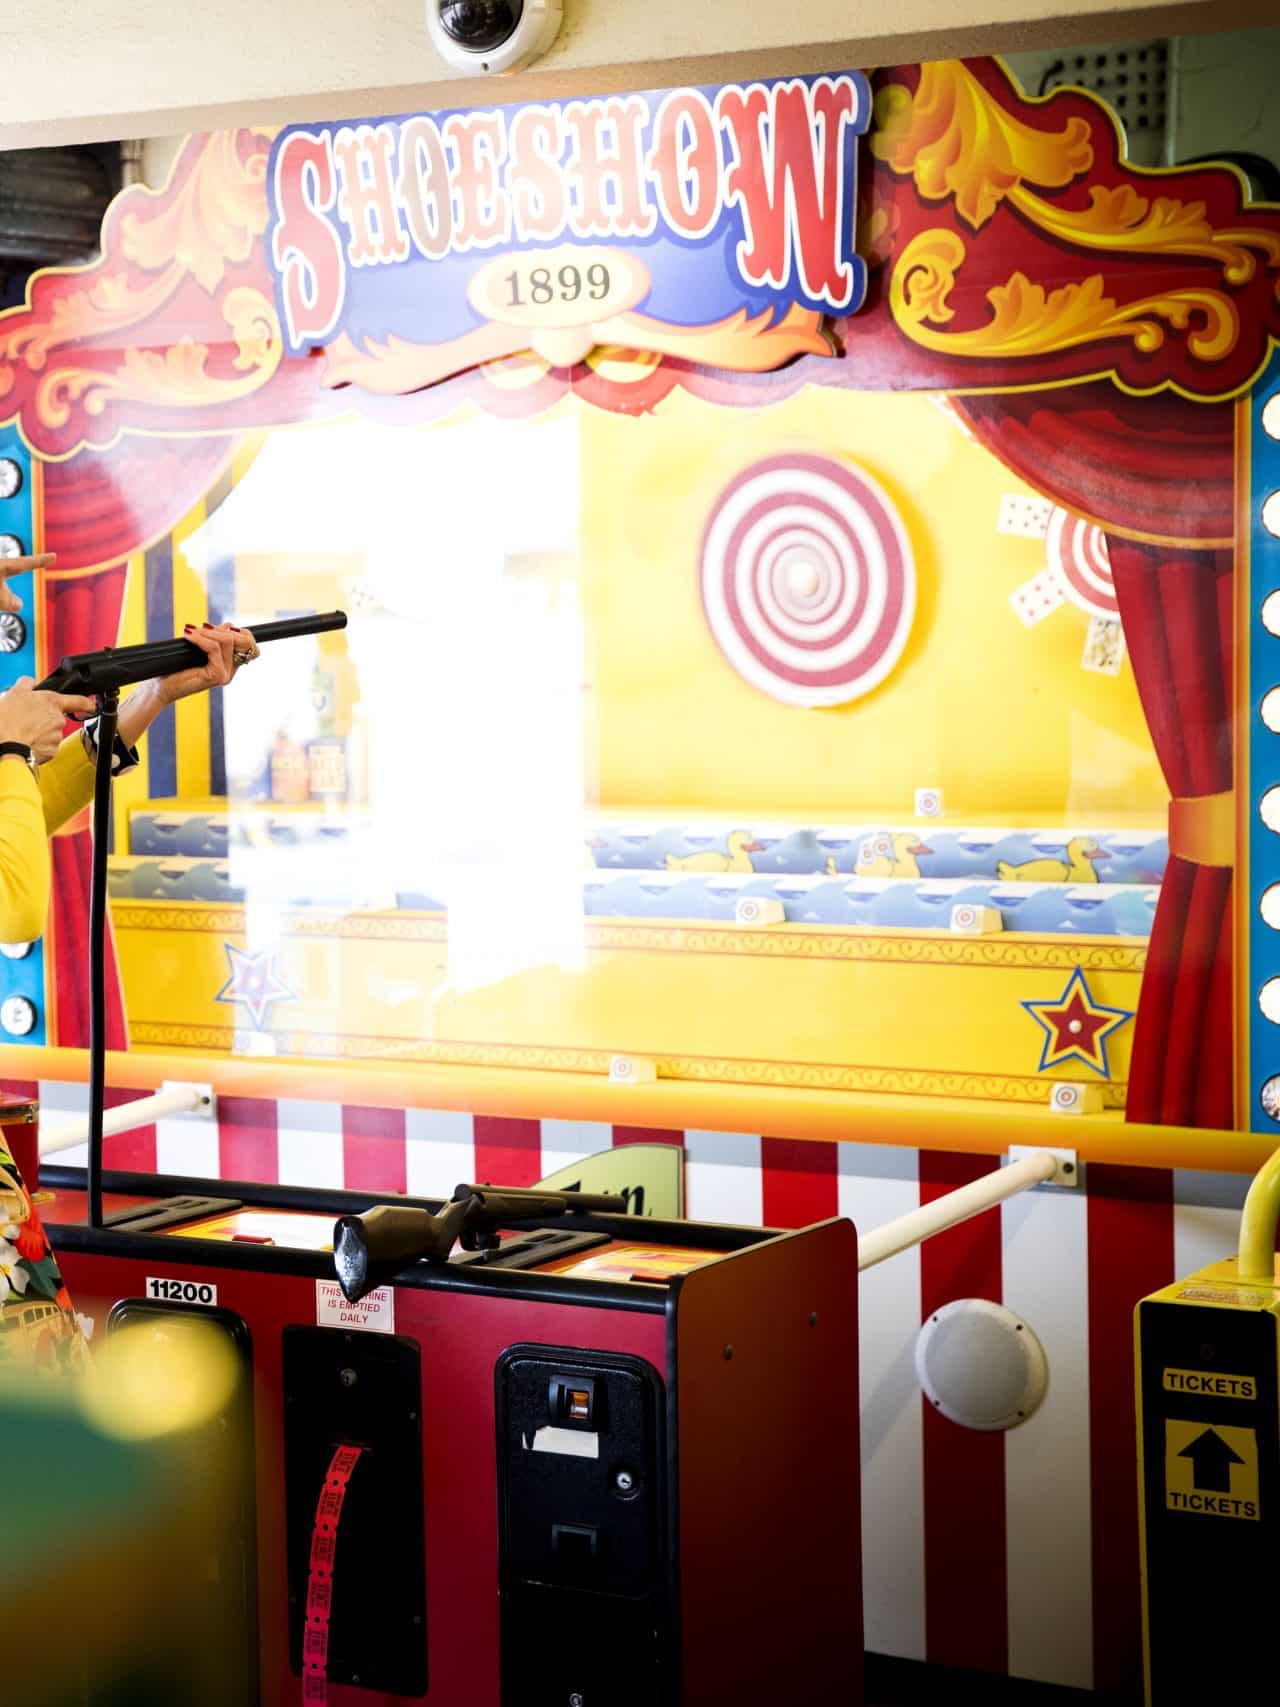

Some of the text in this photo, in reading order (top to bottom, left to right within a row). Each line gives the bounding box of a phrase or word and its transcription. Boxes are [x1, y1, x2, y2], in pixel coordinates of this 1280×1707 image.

[272, 77, 860, 350] SHOESHOW
[504, 263, 610, 307] 1899
[150, 1279, 213, 1303] 11200
[321, 1286, 341, 1297] THIS
[328, 1299, 380, 1312] IS EMPTIED
[340, 1312, 369, 1324] DAILY
[1167, 1373, 1254, 1396] TICKETS
[1169, 1492, 1256, 1517] TICKETS
